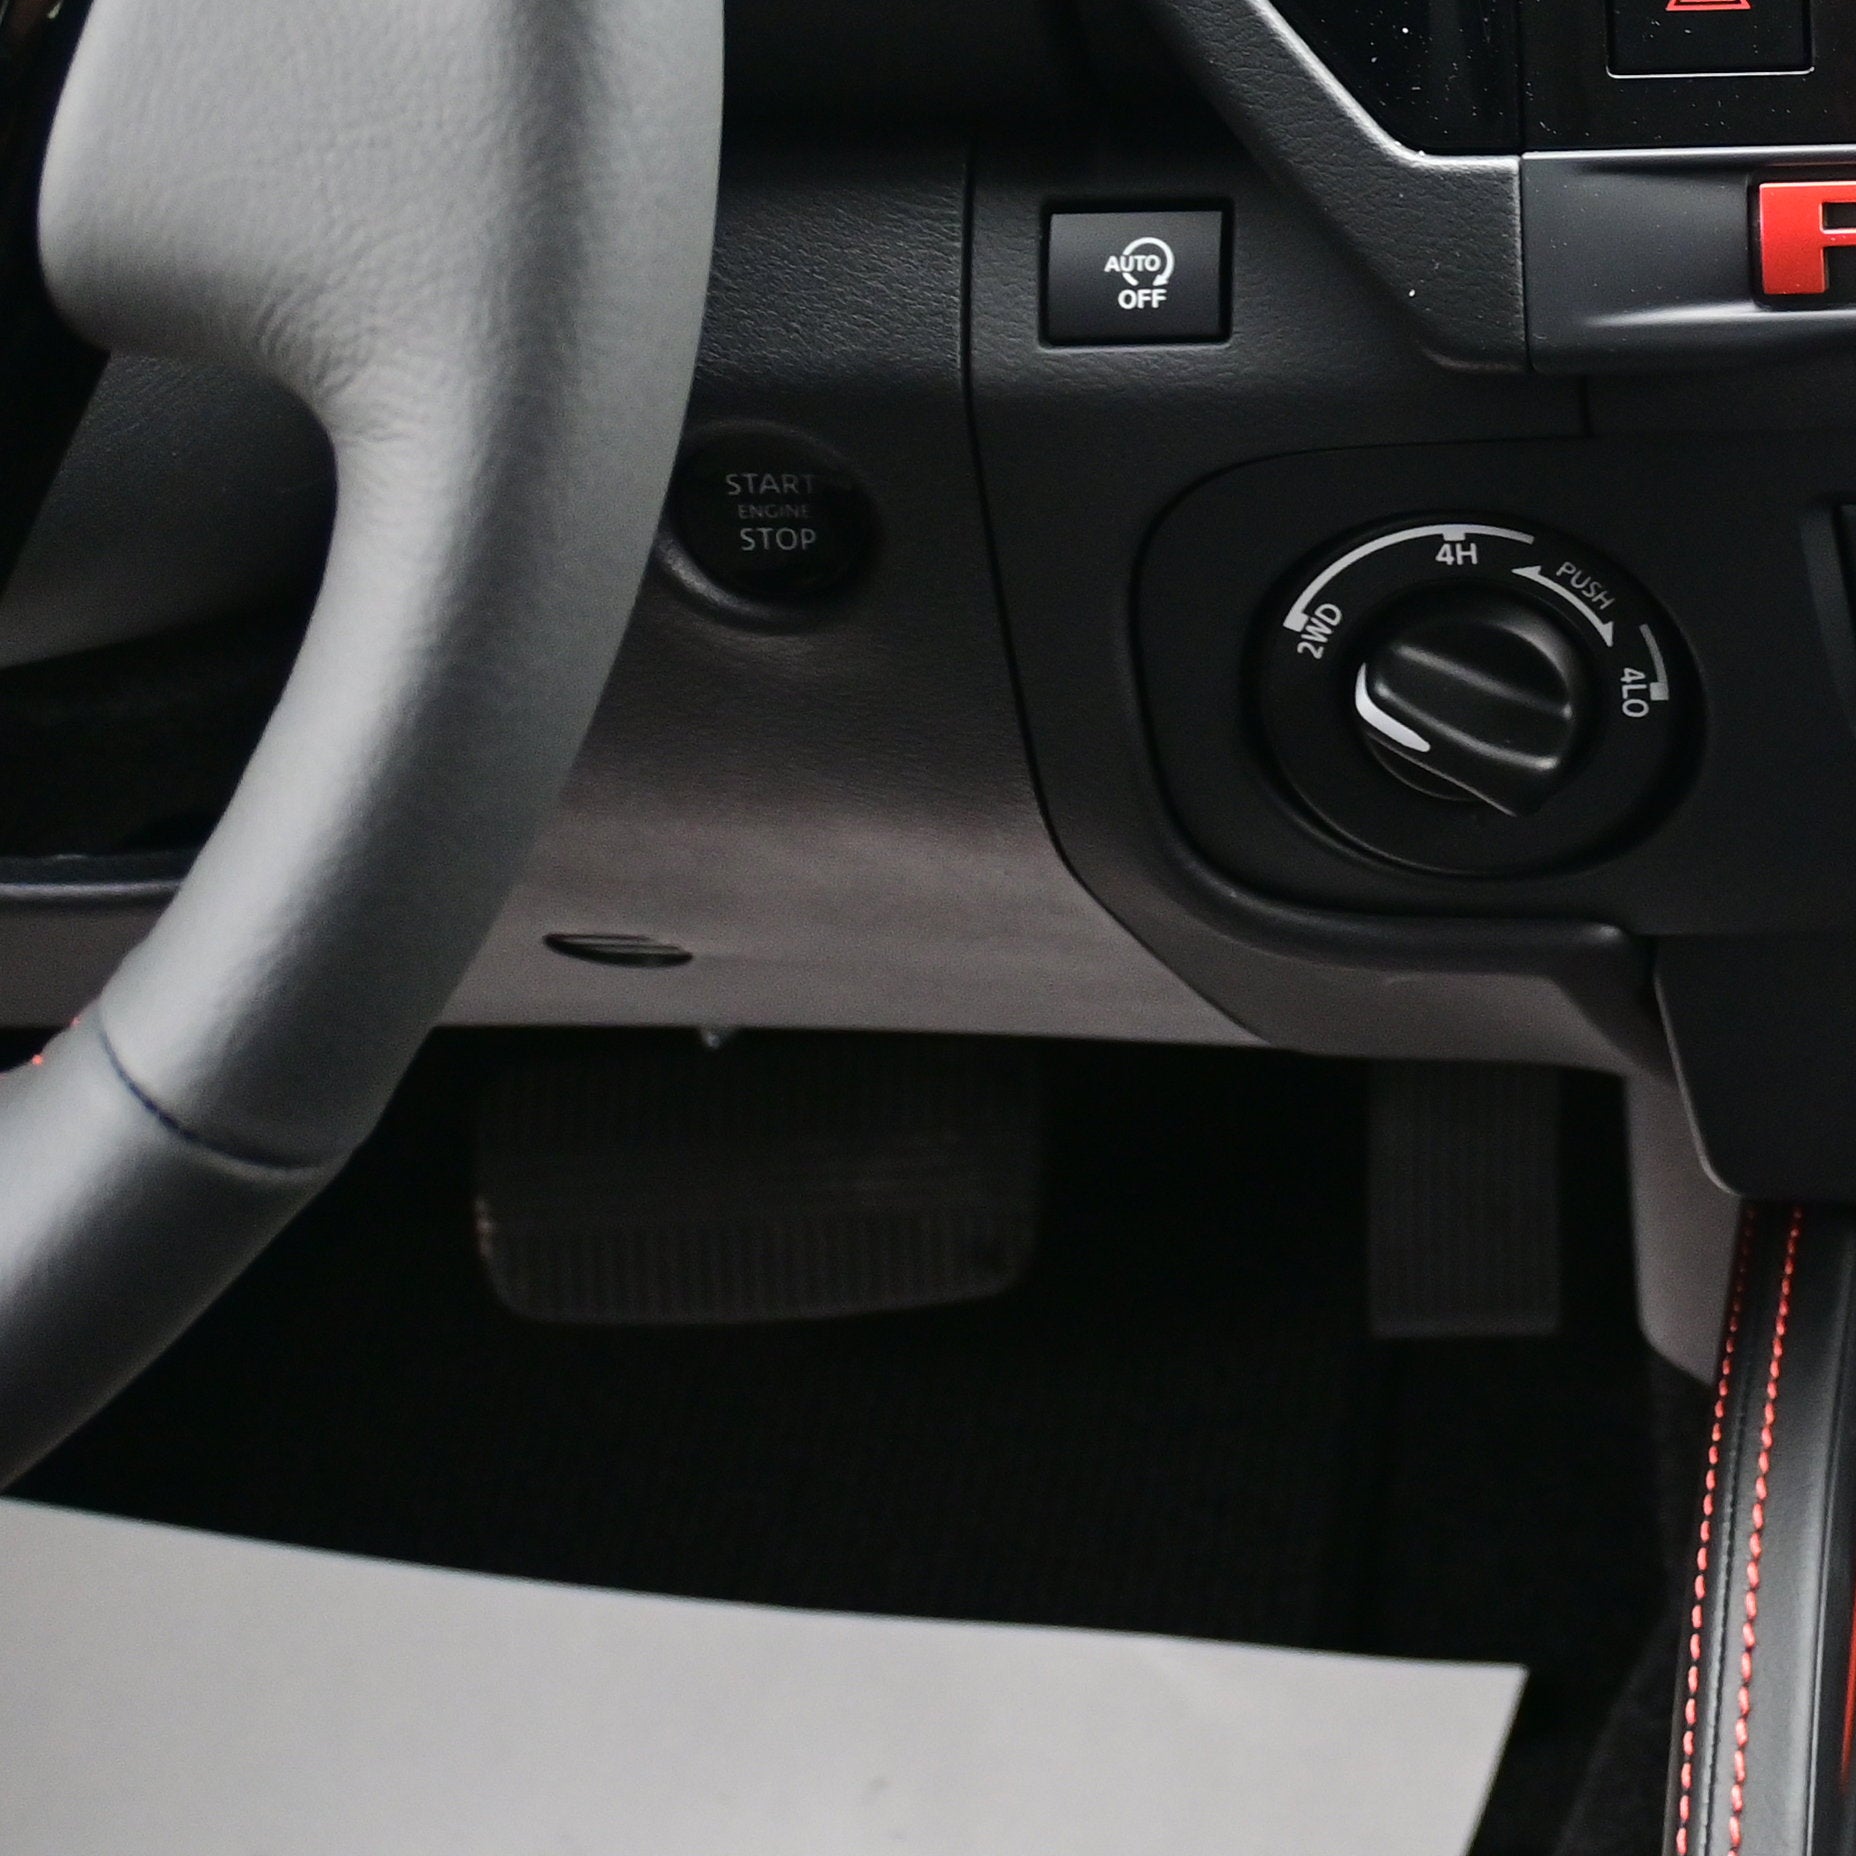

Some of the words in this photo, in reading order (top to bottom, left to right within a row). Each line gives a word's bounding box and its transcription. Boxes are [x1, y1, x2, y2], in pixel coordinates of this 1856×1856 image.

[1103, 253, 1161, 273] AUTO
[1117, 288, 1168, 310] OFF
[725, 472, 817, 495] START
[737, 503, 811, 519] ENGINE
[739, 527, 817, 551] STOP
[1435, 542, 1479, 566] 4H
[1555, 561, 1616, 611] PUSH
[1296, 603, 1344, 660] 2WD
[1618, 665, 1651, 718] 4LO
